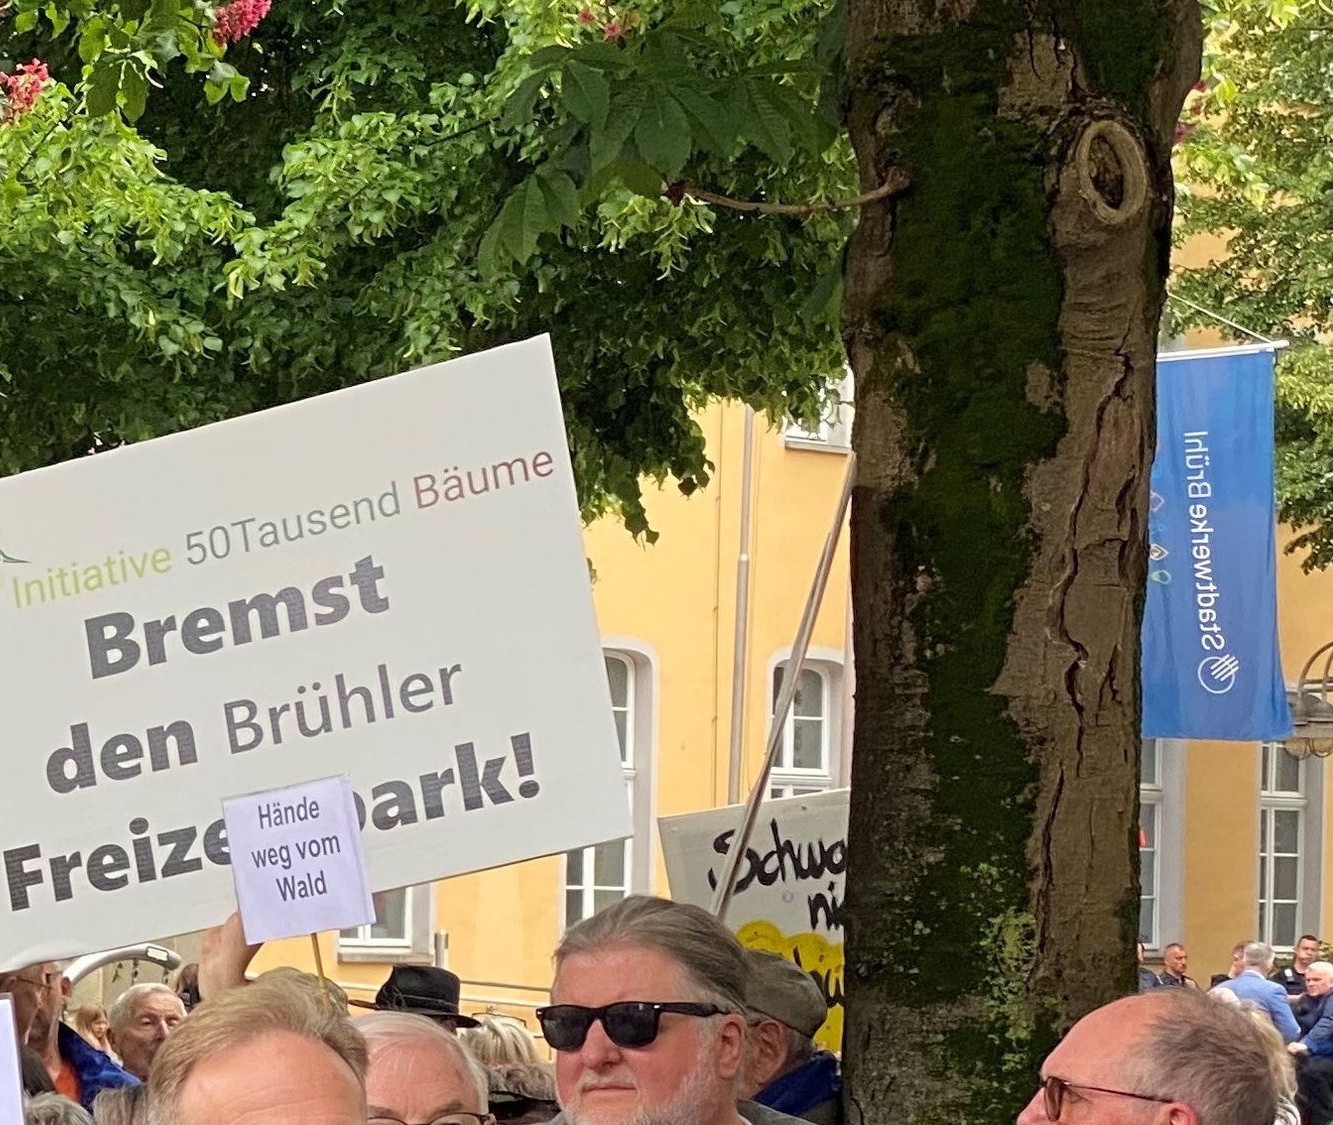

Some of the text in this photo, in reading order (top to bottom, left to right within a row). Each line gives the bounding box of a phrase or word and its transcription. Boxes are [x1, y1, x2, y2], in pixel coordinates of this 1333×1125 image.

[12, 450, 554, 609] Initiative 50Tausend Bäume
[84, 555, 391, 680] Bremst
[46, 663, 462, 794] den Brühler
[2, 732, 541, 912] Freizeark!
[251, 834, 341, 880] weg vom
[257, 796, 320, 830] Hände
[275, 869, 328, 902] Wald
